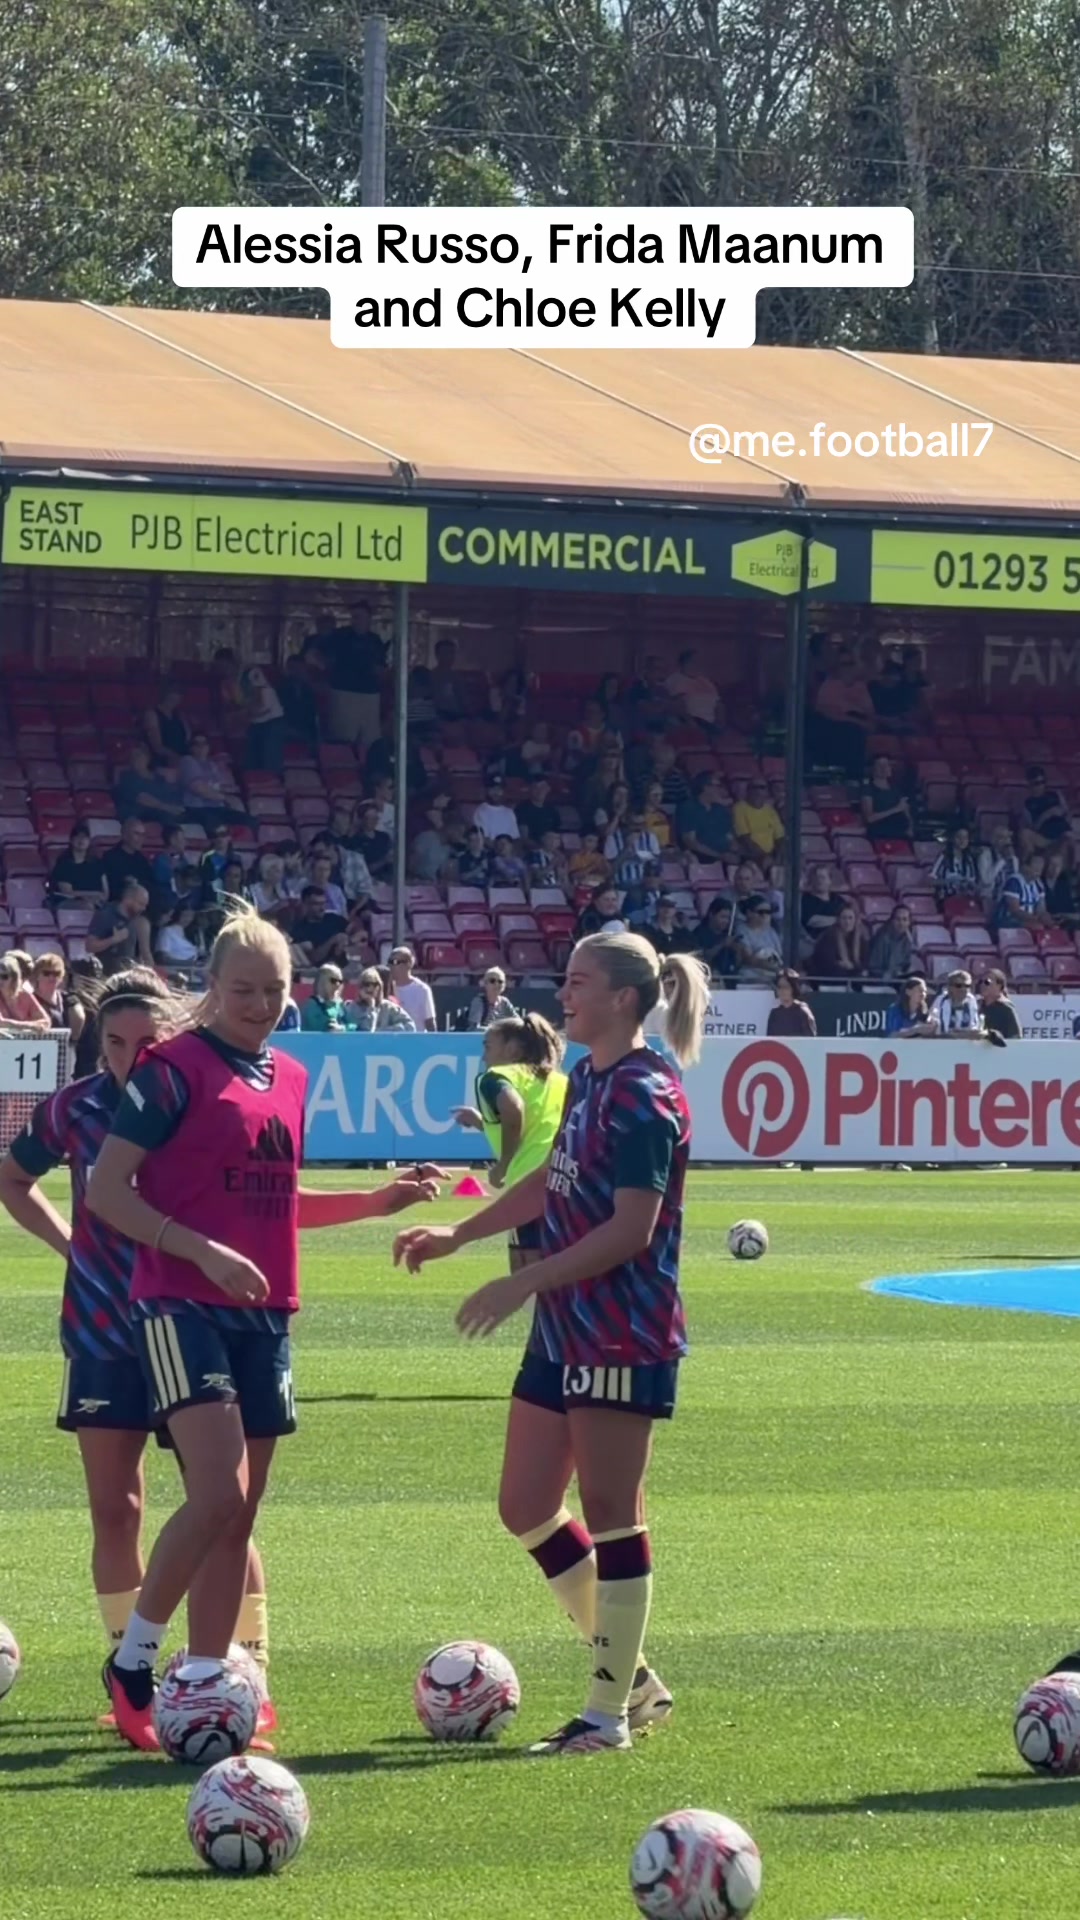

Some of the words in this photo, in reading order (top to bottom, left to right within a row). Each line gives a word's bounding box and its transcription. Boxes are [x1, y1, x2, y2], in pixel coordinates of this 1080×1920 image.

[20, 500, 83, 526] EAST
[20, 528, 102, 553] STAND
[131, 514, 182, 551] PJB
[196, 517, 342, 559] Electrical
[356, 524, 402, 562] Ltd
[438, 527, 706, 575] COMMERCIAL
[749, 562, 799, 578] Electrical
[934, 550, 1048, 593] 01293
[14, 1053, 42, 1080] 11
